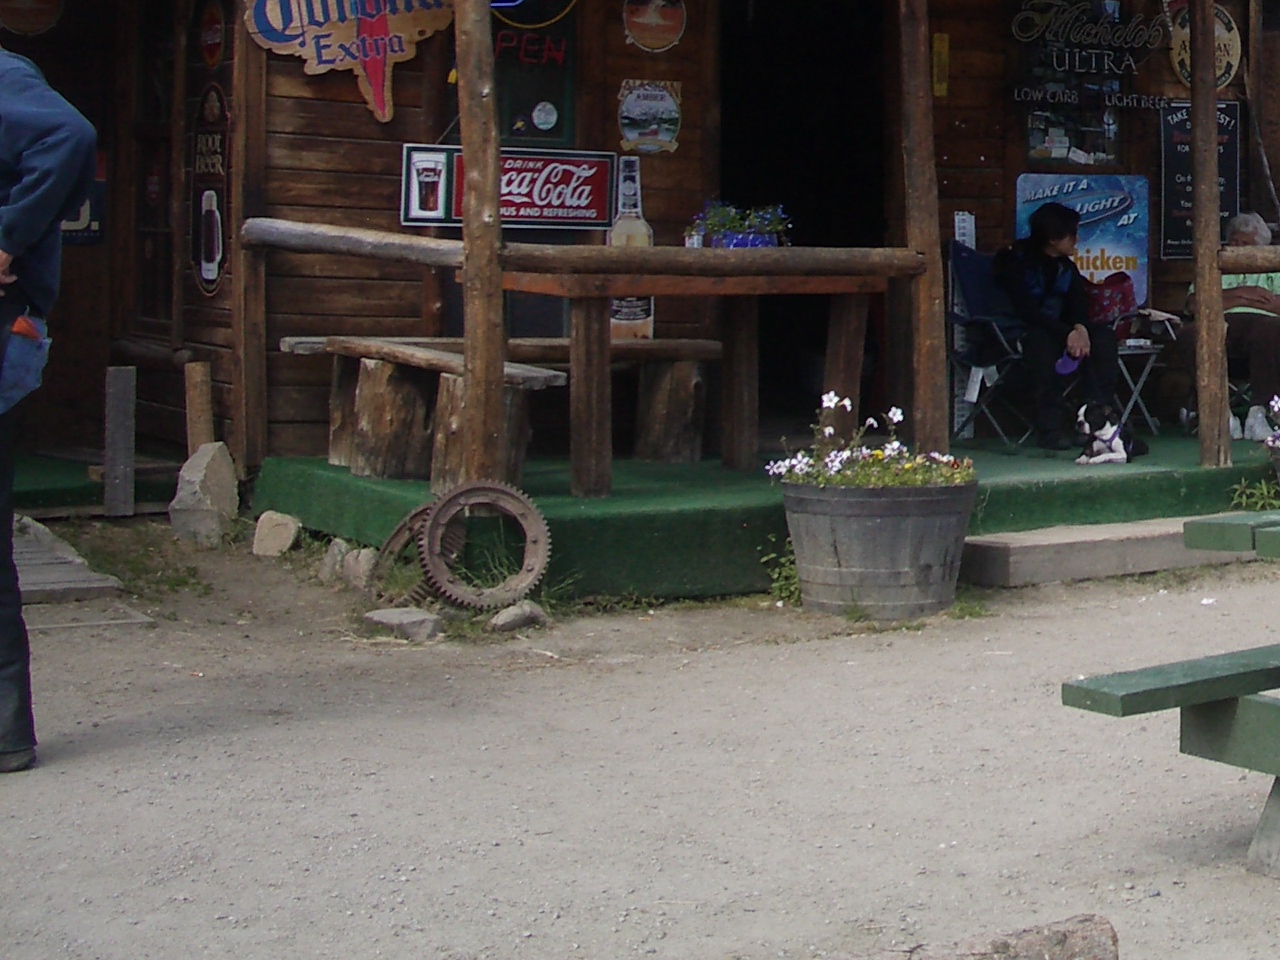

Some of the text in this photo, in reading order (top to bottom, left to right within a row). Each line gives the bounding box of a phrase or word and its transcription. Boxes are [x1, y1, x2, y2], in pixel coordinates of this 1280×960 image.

[312, 33, 406, 66] Extra
[494, 30, 566, 66] PEN
[1052, 48, 1139, 75] ULTRA
[1014, 88, 1169, 109] LOW CARB LIGHT BEER
[1167, 108, 1189, 125] TAKE
[504, 159, 545, 169] DRINK
[1023, 179, 1088, 202] MAKE IT A
[520, 207, 541, 217] AND
[542, 208, 599, 219] REFRESHING
[1077, 195, 1124, 215] LIGHT
[1117, 213, 1139, 227] AT
[1073, 247, 1138, 271] hicken
